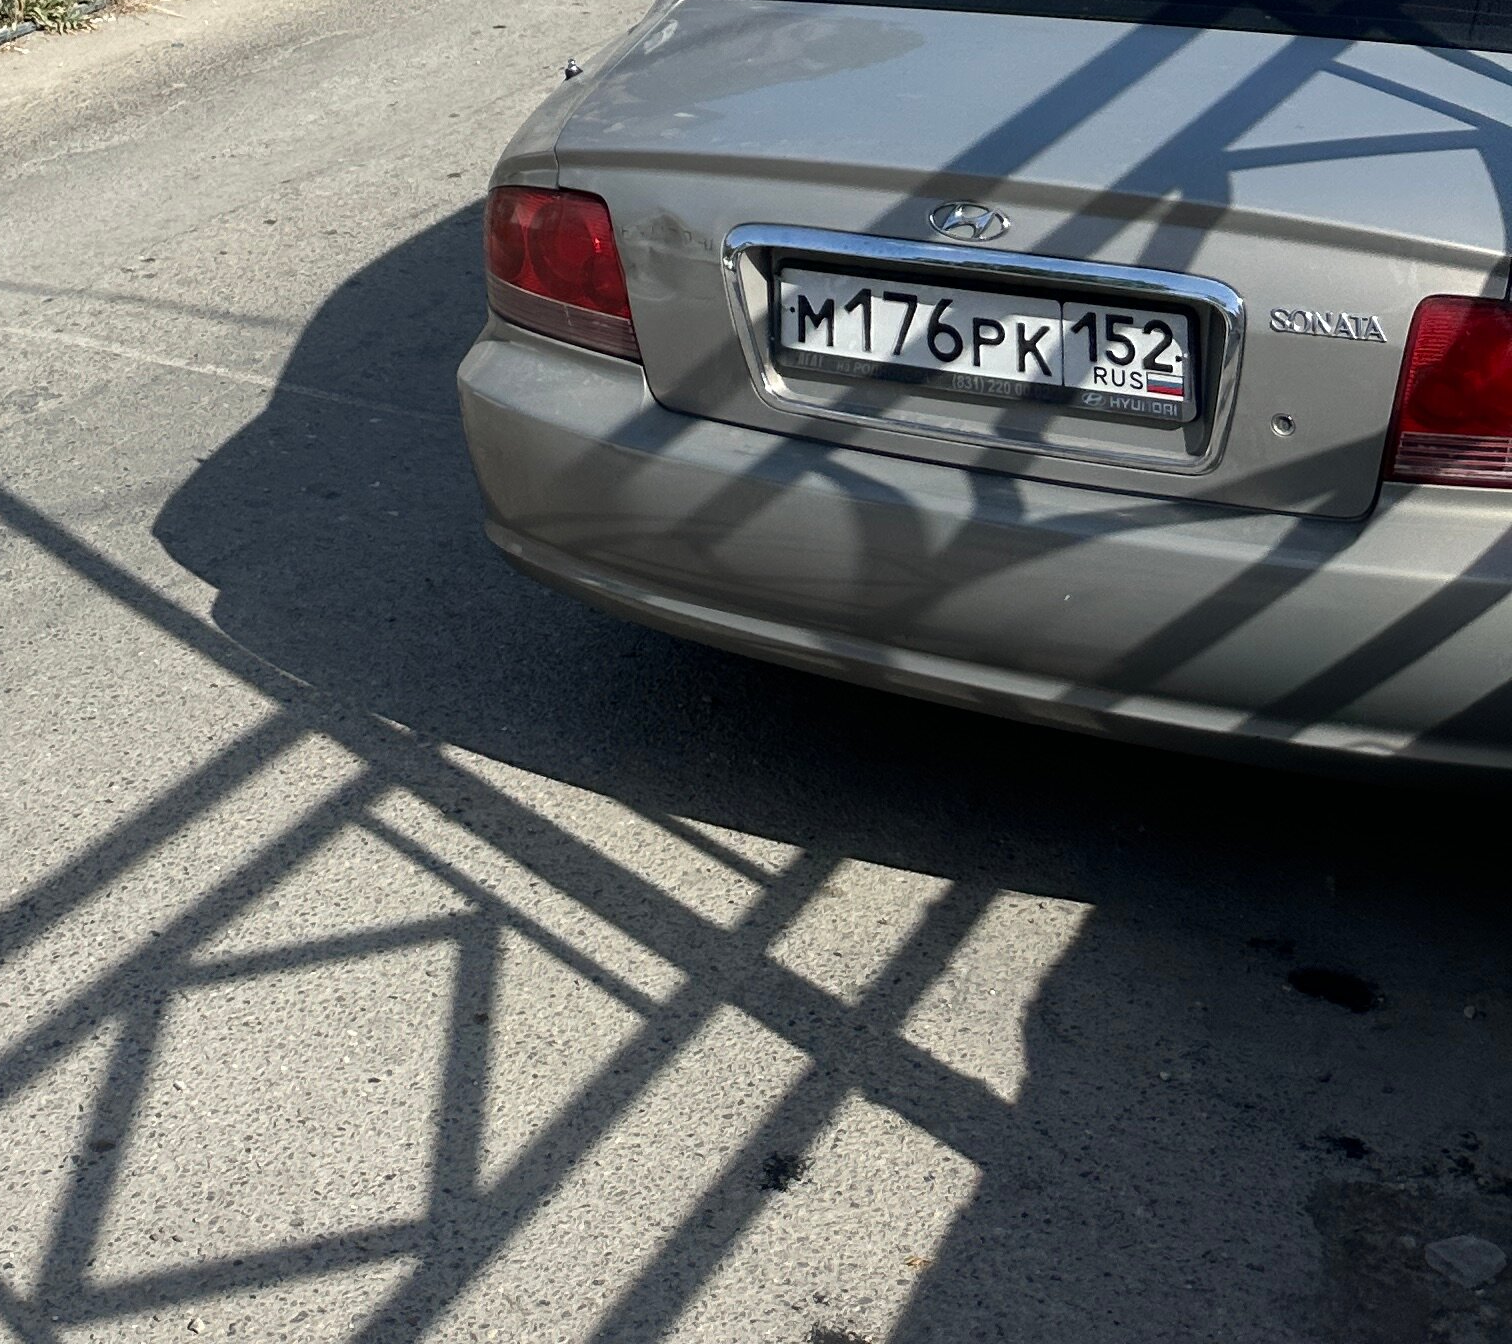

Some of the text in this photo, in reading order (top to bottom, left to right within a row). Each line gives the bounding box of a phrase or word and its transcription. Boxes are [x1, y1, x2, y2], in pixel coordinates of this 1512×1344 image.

[1270, 308, 1387, 343] SONATA
[1071, 313, 1175, 373] 152
[952, 373, 984, 392] (831)
[989, 380, 1011, 395] 220
[1094, 367, 1144, 390] RUS
